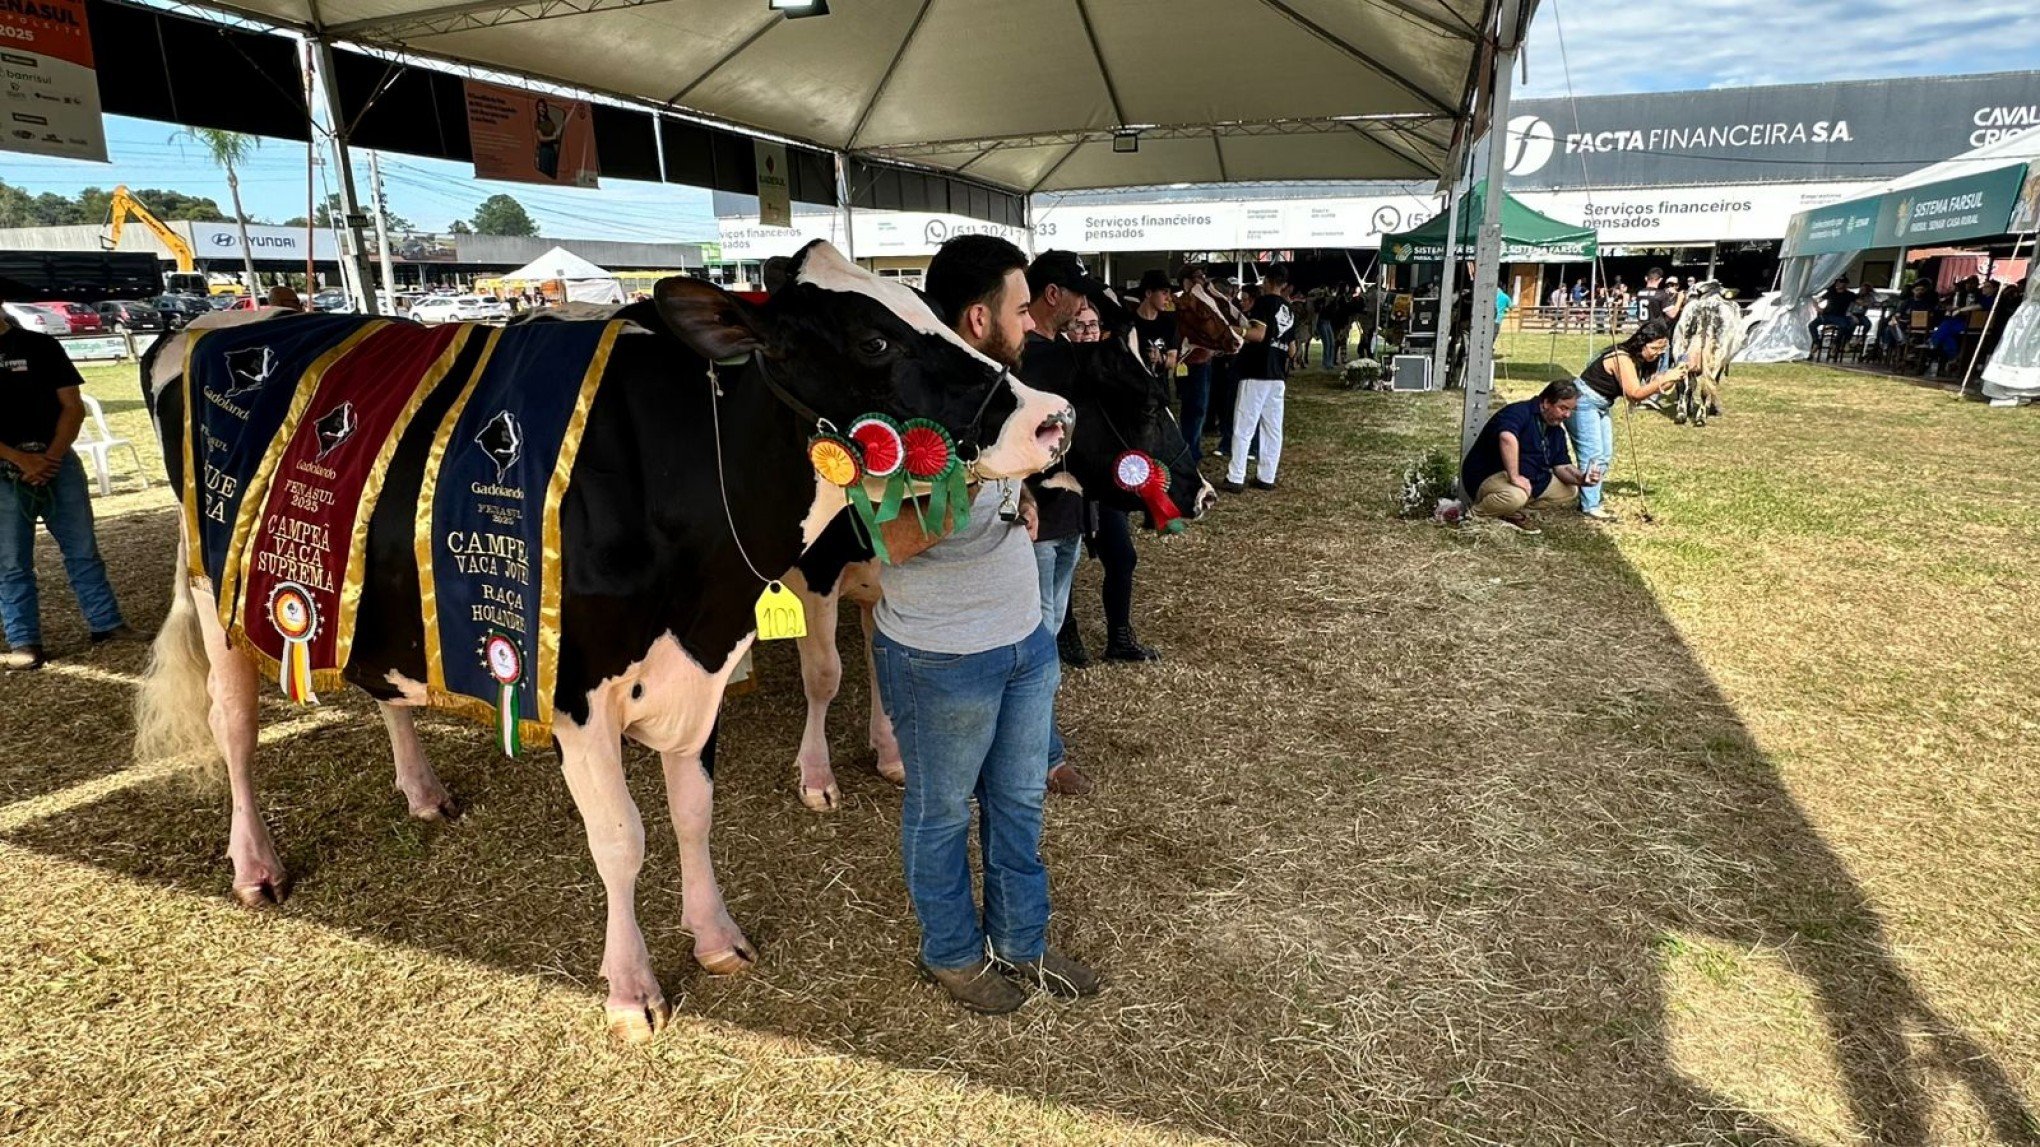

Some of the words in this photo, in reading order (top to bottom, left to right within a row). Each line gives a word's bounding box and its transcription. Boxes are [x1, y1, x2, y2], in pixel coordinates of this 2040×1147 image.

[0, 24, 34, 41] 2025
[6, 69, 52, 85] banrisul
[1565, 129, 1645, 154] FACTA
[1649, 122, 1807, 150] FINANCEIRA
[1584, 201, 1653, 218] Serviços
[1658, 199, 1752, 214] financeiros
[1914, 198, 1949, 218] SISTEMA
[1949, 191, 1984, 212] FARSUL
[1085, 215, 1139, 230] Serviços
[1141, 213, 1212, 227] financeiros
[1582, 216, 1660, 228] pensados
[1085, 227, 1145, 242] pensados
[203, 385, 250, 420] Gadoland
[296, 459, 337, 480] Gadolando
[284, 479, 336, 506] FENASUL
[471, 481, 525, 500] Gadolando
[291, 494, 319, 513] 2025
[268, 514, 331, 552] CAMPEÃ
[273, 535, 323, 568] VACA
[258, 551, 335, 594] SUPREMA
[455, 555, 498, 576] VACA
[482, 583, 524, 611] RAÇA
